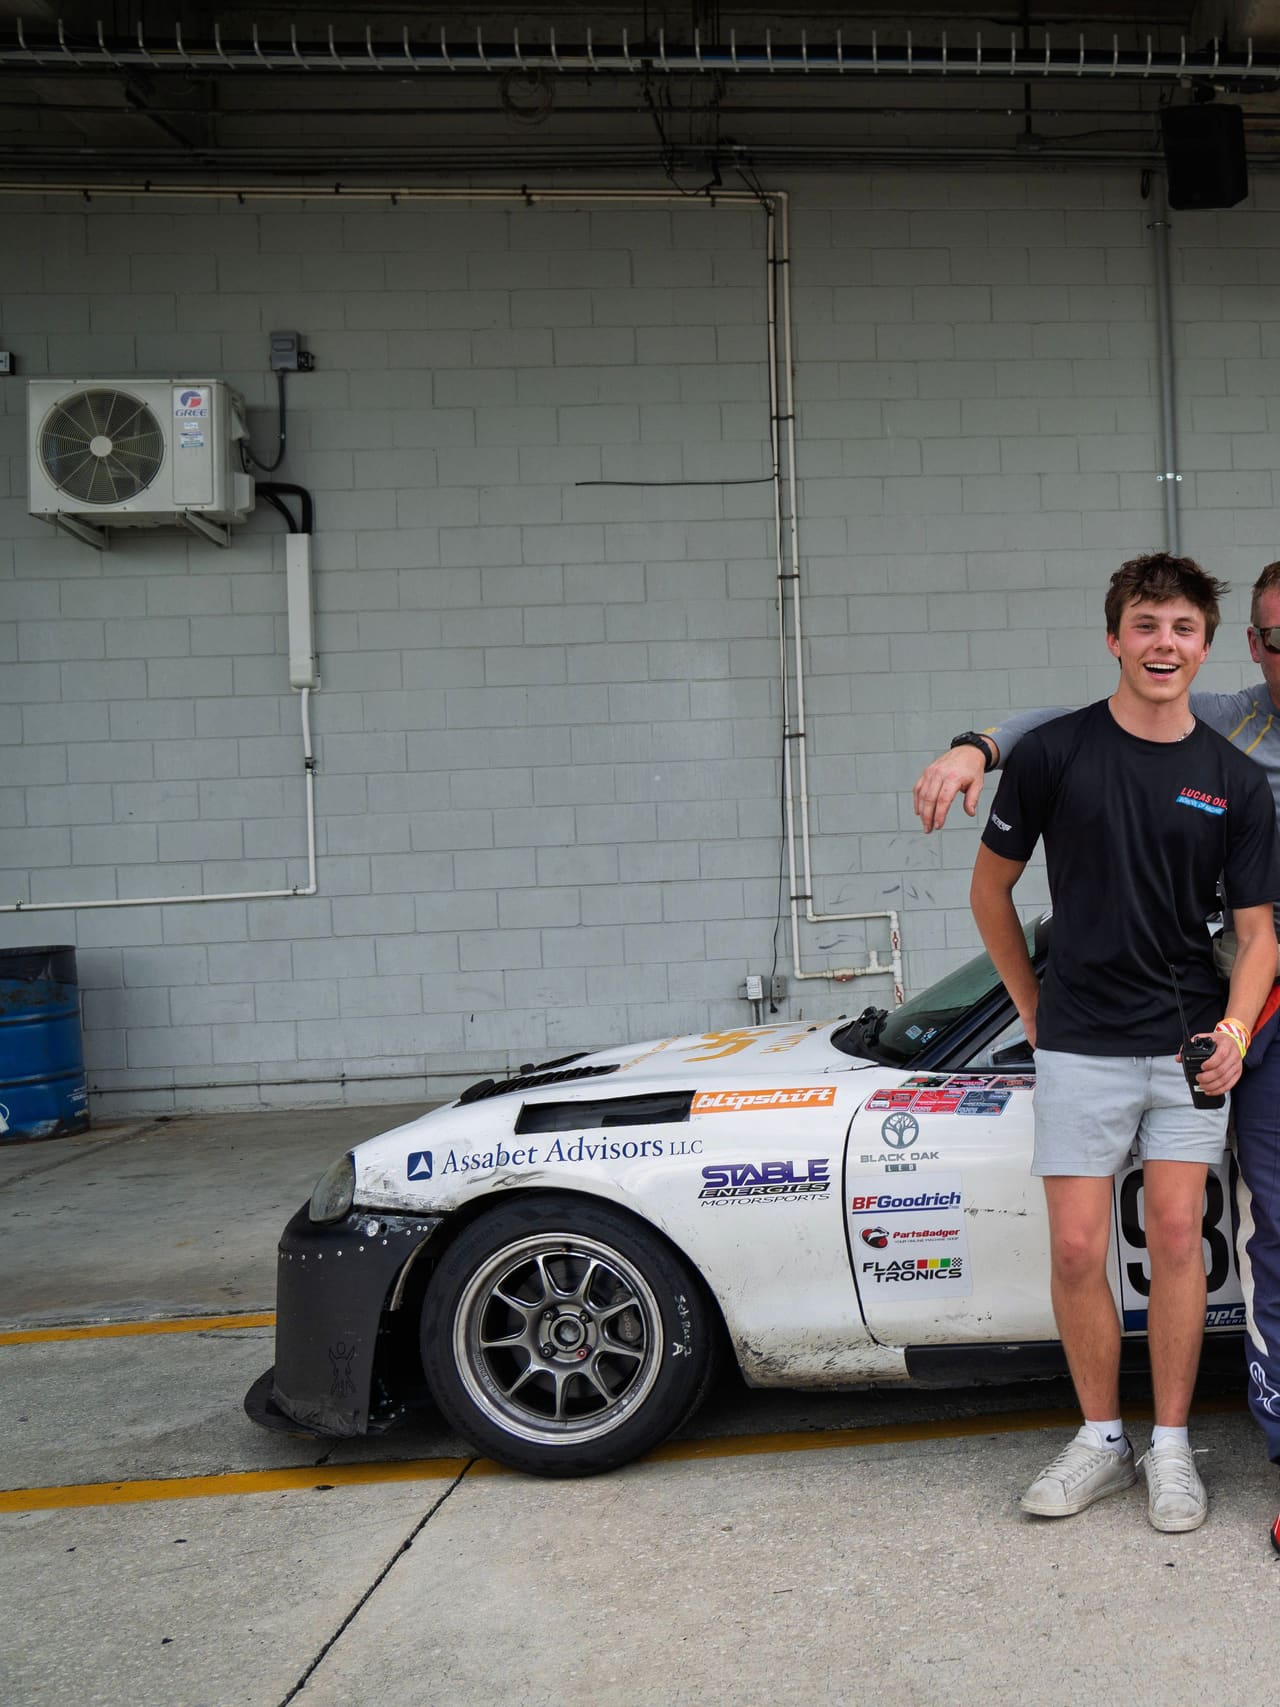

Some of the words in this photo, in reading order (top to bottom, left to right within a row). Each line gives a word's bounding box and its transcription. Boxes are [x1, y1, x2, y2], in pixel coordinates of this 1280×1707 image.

[175, 409, 208, 417] GREE
[1180, 786, 1213, 804] LUCAS
[1212, 796, 1228, 808] OIL
[696, 1089, 833, 1110] blipshift
[440, 1143, 538, 1175] Assabet
[543, 1136, 664, 1163] Advisors
[669, 1140, 703, 1156] LLC
[860, 1153, 905, 1163] BLACK
[911, 1151, 940, 1161] OAK
[701, 1159, 831, 1188] STABLE
[699, 1183, 829, 1198] ENERGIES
[701, 1194, 831, 1207] MOTORSPORTS
[852, 1191, 961, 1210] BFGoodrich
[893, 1229, 961, 1239] PartsBadger
[863, 1259, 916, 1273] FLAG
[874, 1268, 963, 1283] TRONICS
